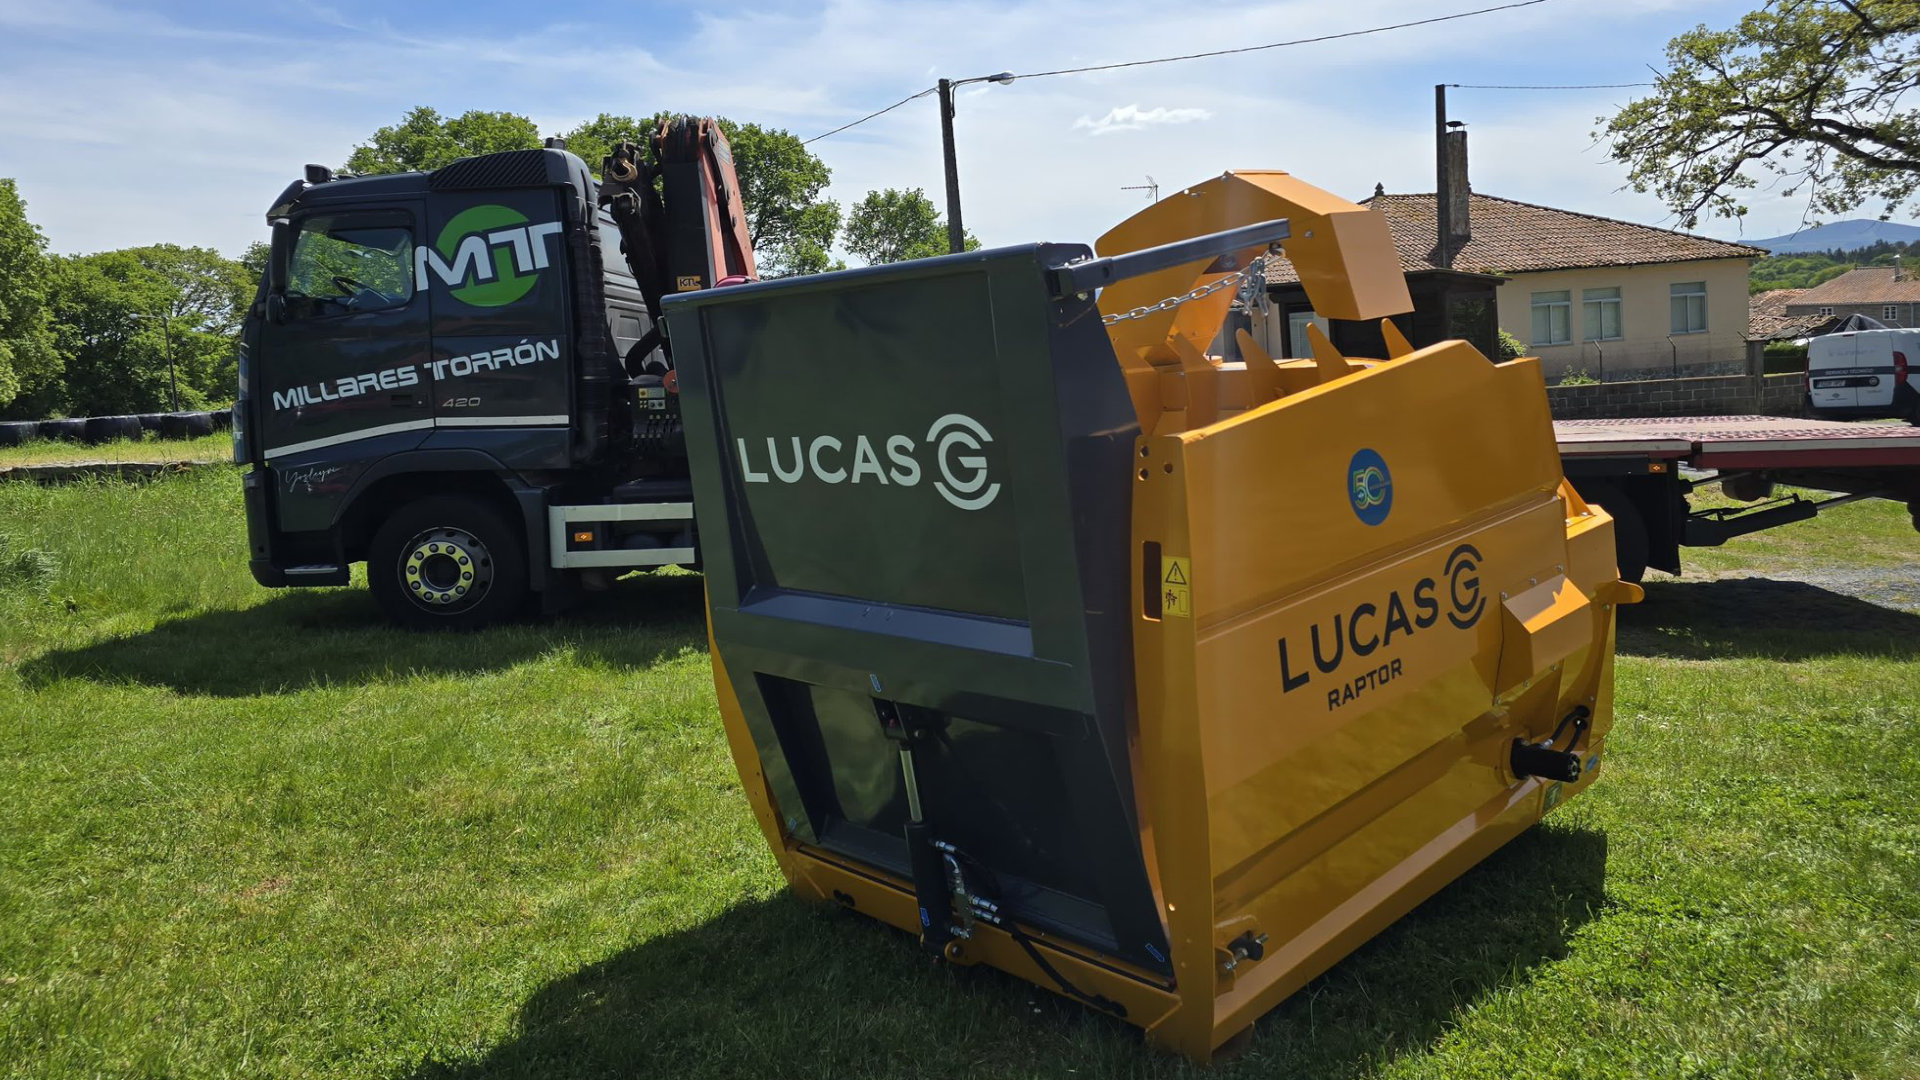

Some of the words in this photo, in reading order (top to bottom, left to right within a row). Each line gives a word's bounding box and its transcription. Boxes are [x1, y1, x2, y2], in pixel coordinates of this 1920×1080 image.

[272, 365, 419, 411] MILLARES
[423, 339, 560, 381] TORRÓN
[442, 397, 481, 408] 420
[737, 434, 922, 487] LUCAS
[1278, 577, 1439, 694] LUCAS
[1327, 658, 1403, 712] RAPTOR
